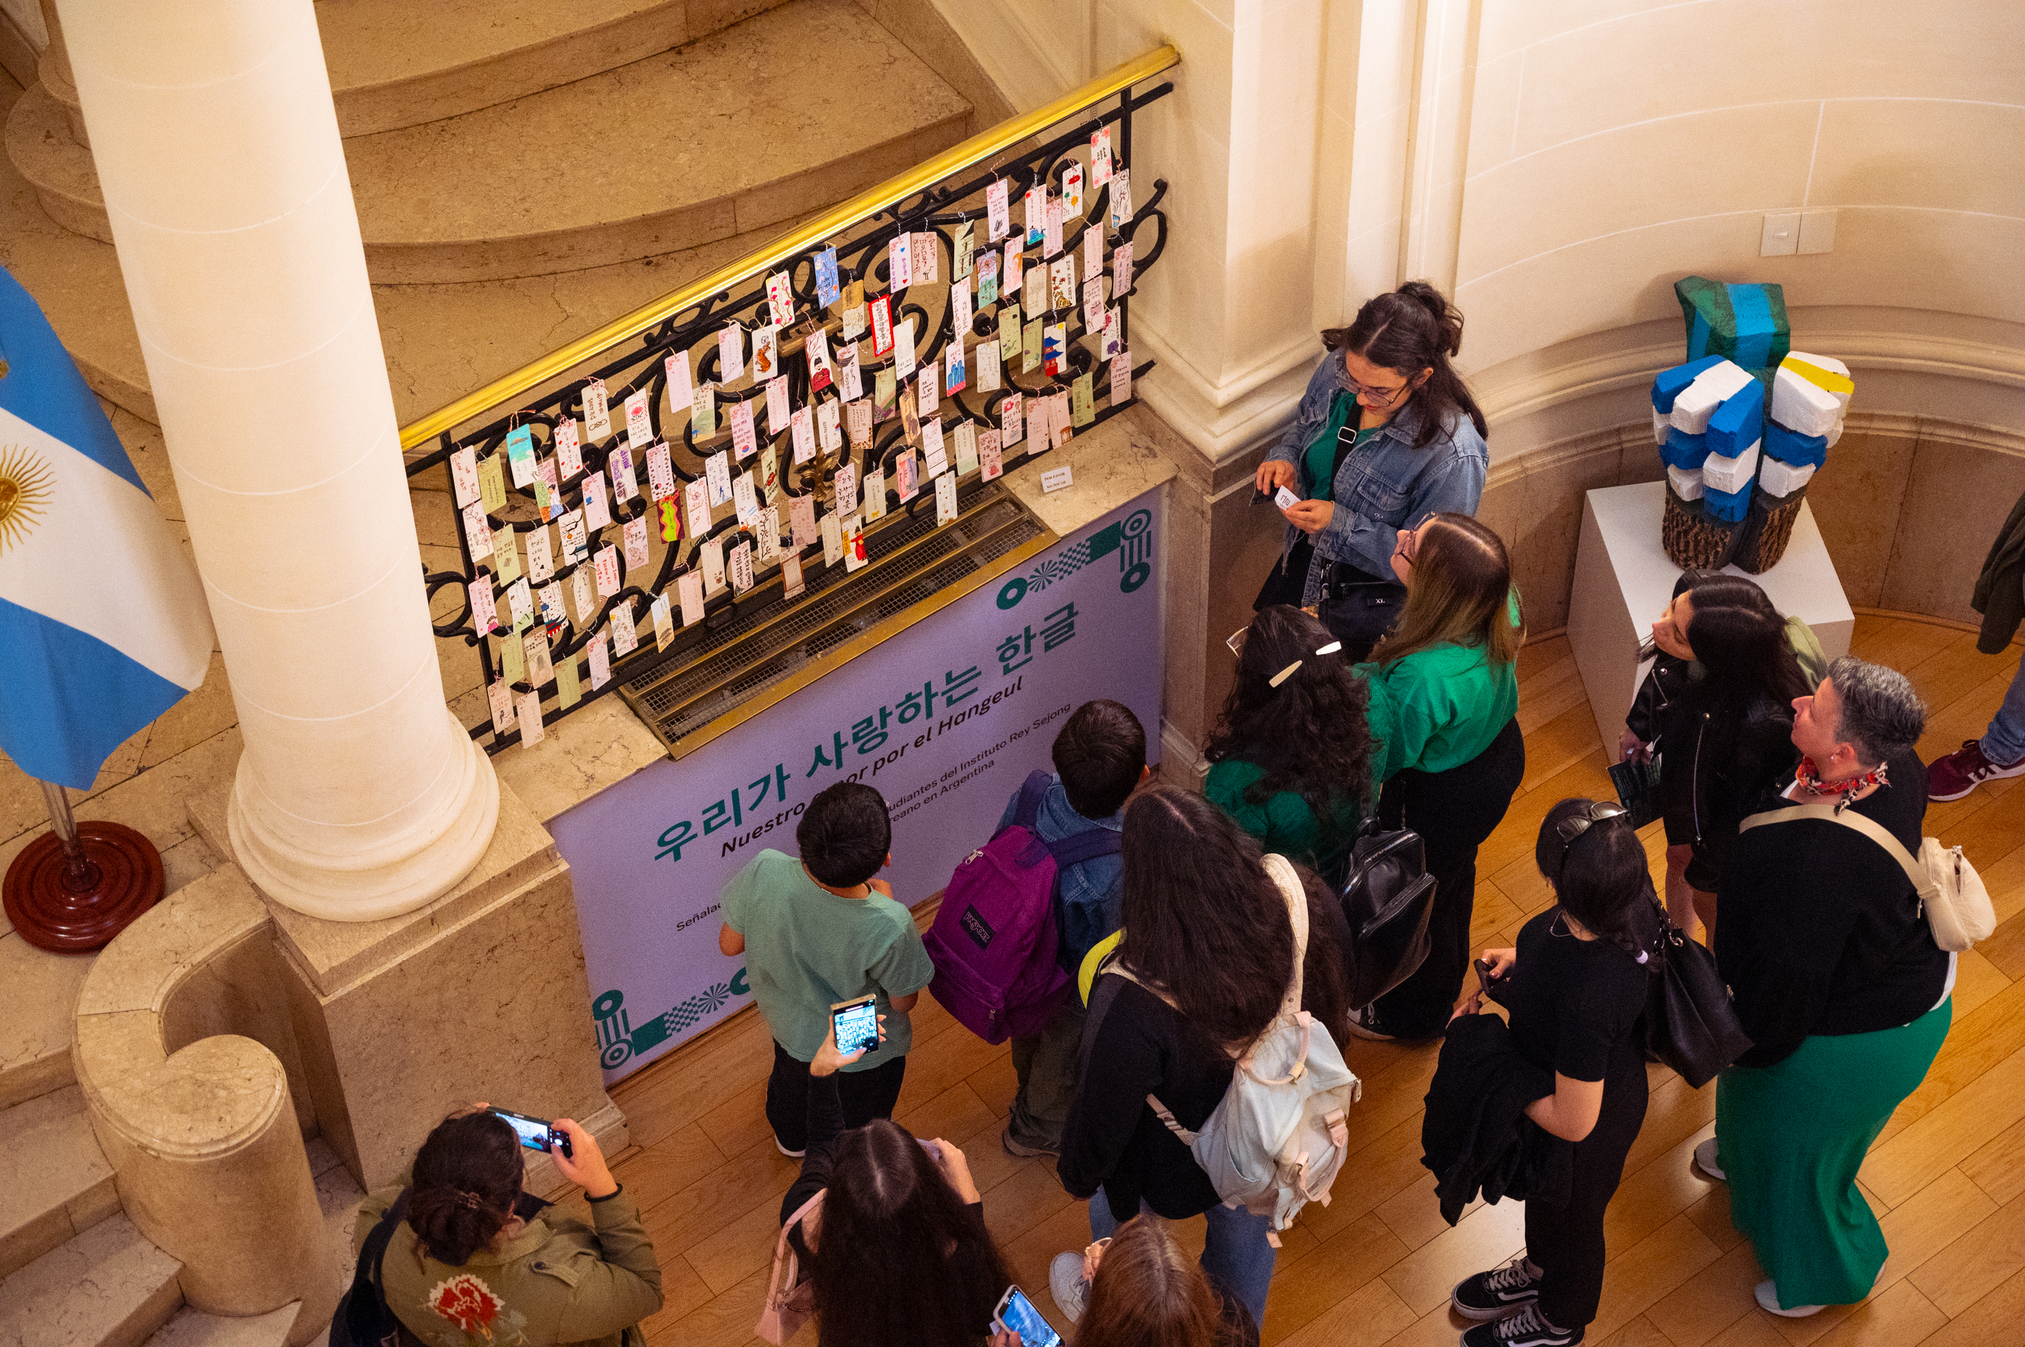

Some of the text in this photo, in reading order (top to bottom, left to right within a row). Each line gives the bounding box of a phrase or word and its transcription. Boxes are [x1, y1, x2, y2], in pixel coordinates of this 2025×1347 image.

[654, 601, 1080, 862] 우리가 사랑하는 한글
[721, 800, 805, 858] Nuestro
[872, 741, 909, 777] por
[913, 726, 931, 749] el
[938, 675, 1023, 736] Hangeul
[889, 780, 938, 812] udiantes
[940, 766, 958, 783] del
[960, 740, 1007, 771] Instituto
[1009, 726, 1031, 743] Rey
[1033, 703, 1071, 730] Sejong
[889, 760, 995, 822] reano en Argentina
